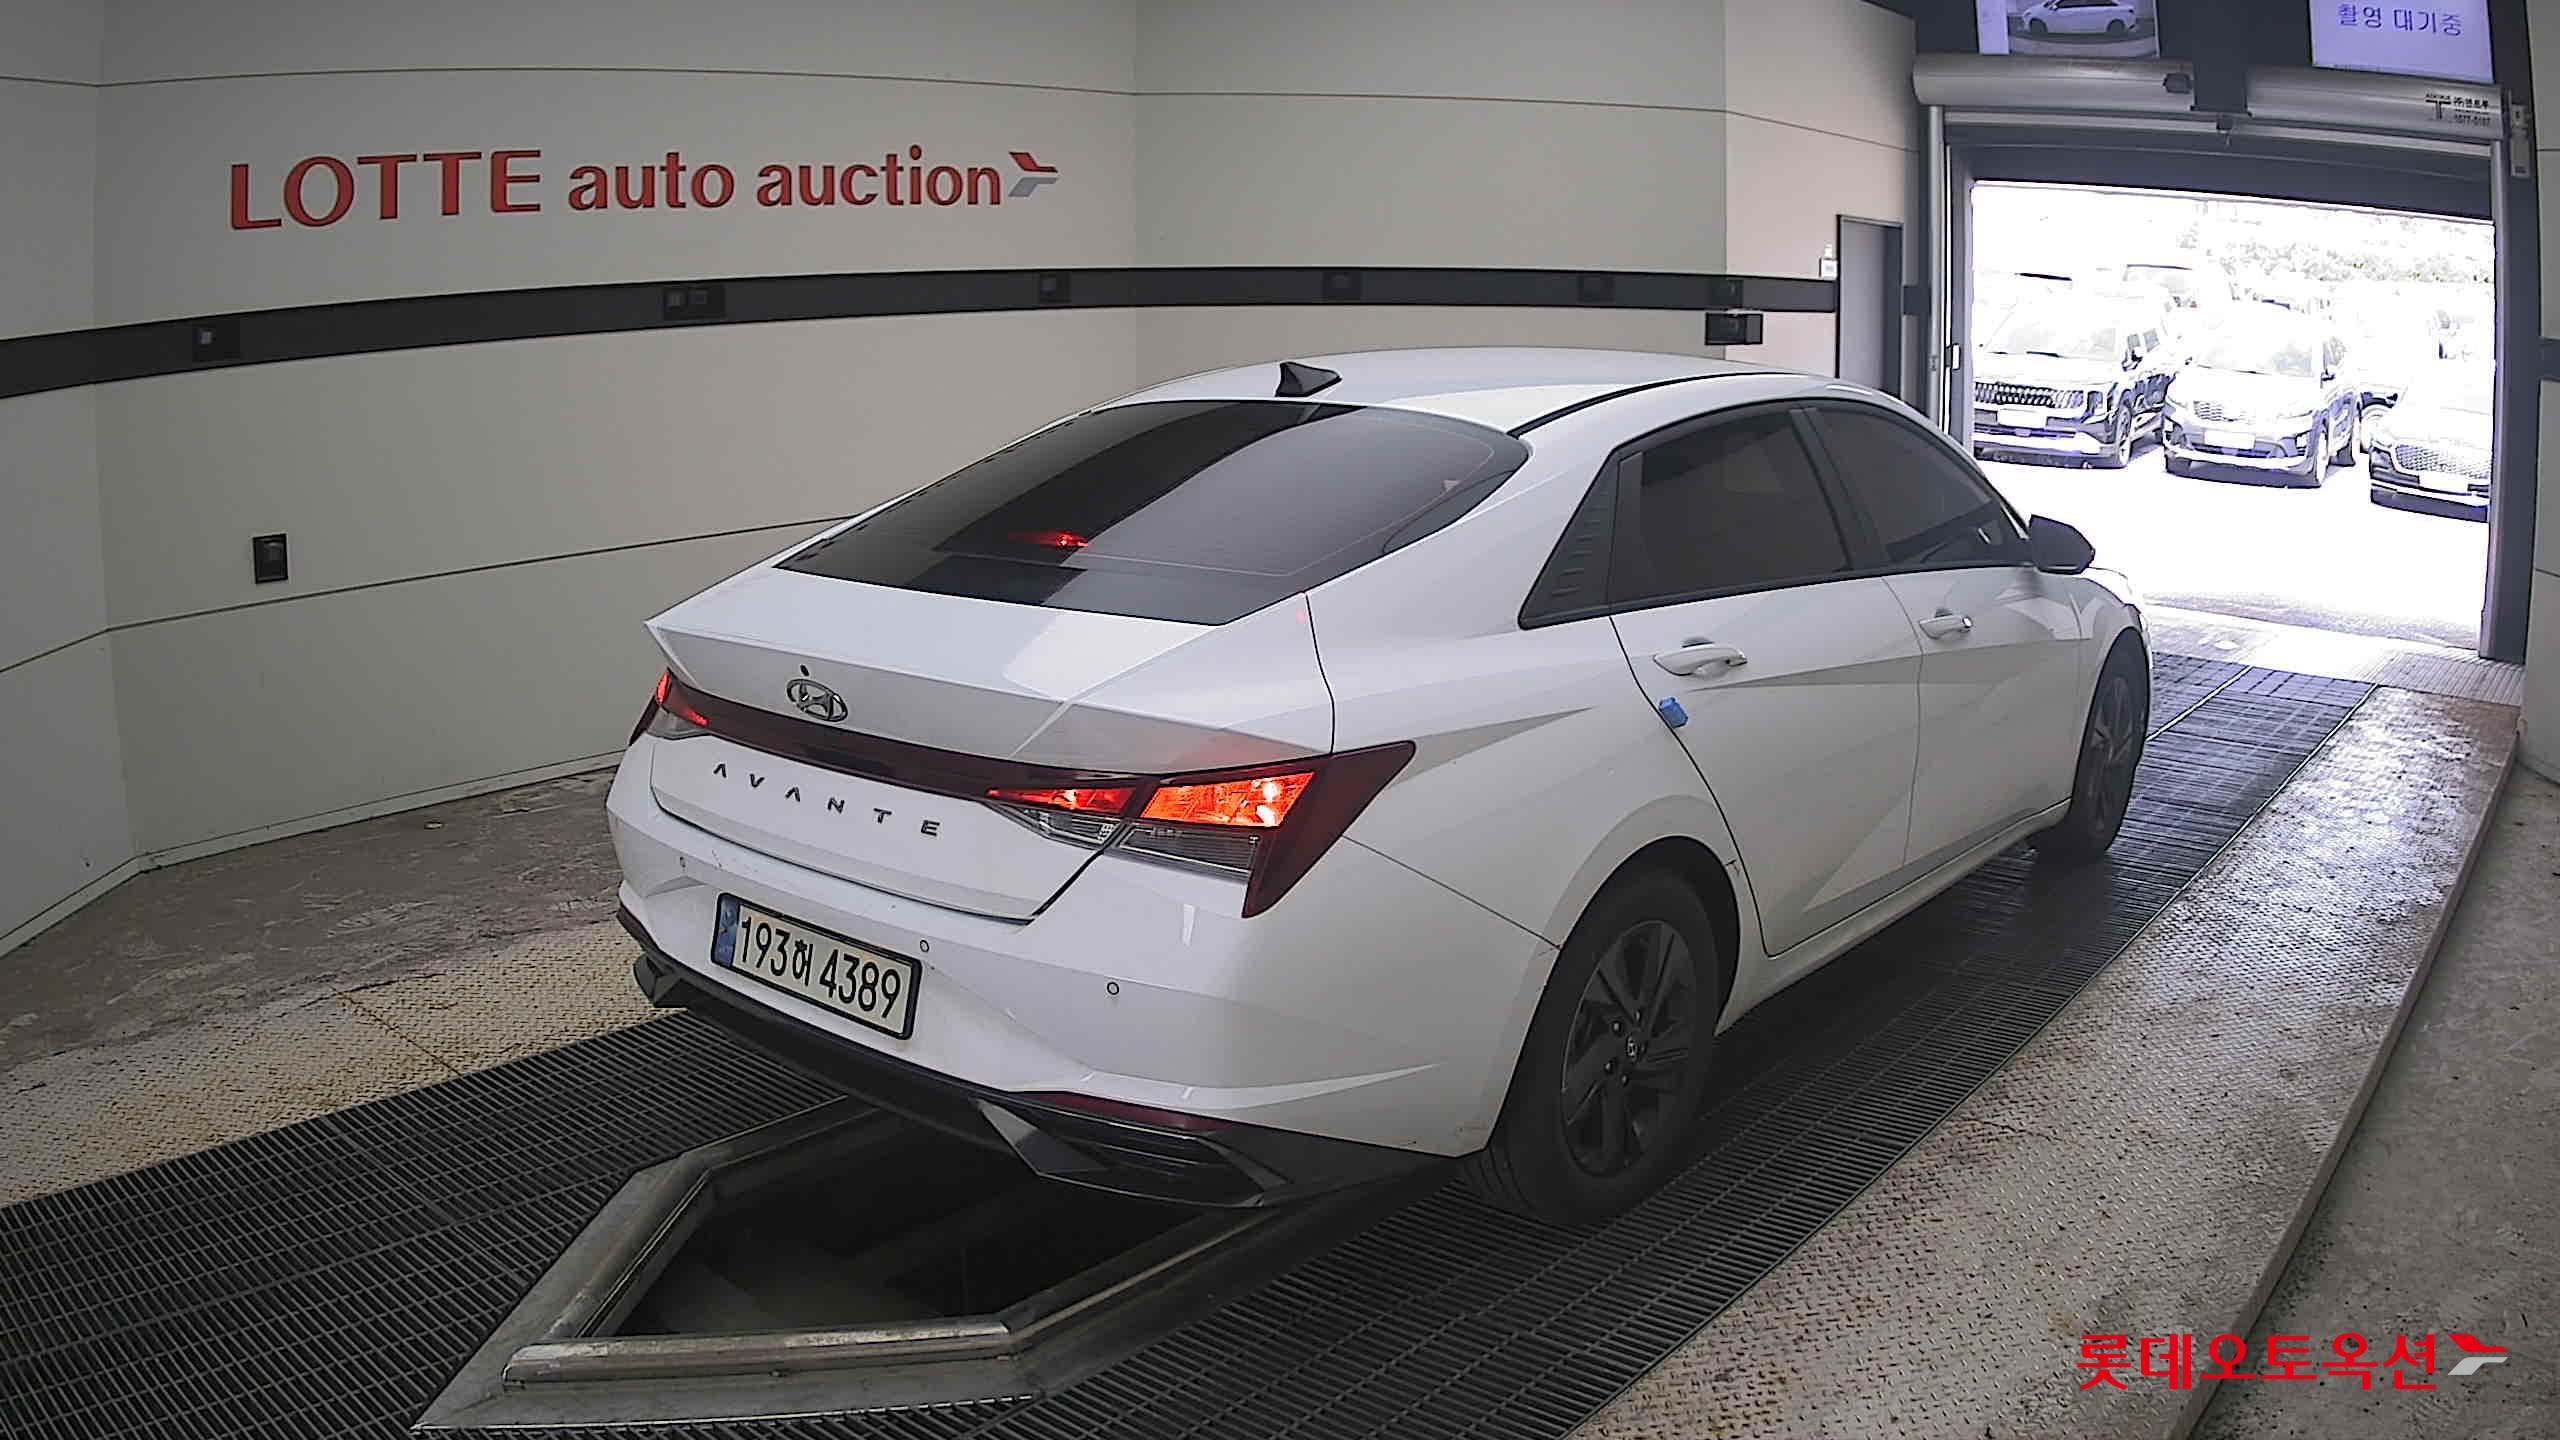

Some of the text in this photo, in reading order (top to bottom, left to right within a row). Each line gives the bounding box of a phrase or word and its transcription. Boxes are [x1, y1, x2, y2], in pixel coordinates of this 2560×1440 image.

[2338, 3, 2462, 36] 촬영 대기중
[231, 144, 1000, 230] LOTTE auto auction
[713, 763, 940, 837] AVANTE
[741, 916, 901, 1018] 193허 4389
